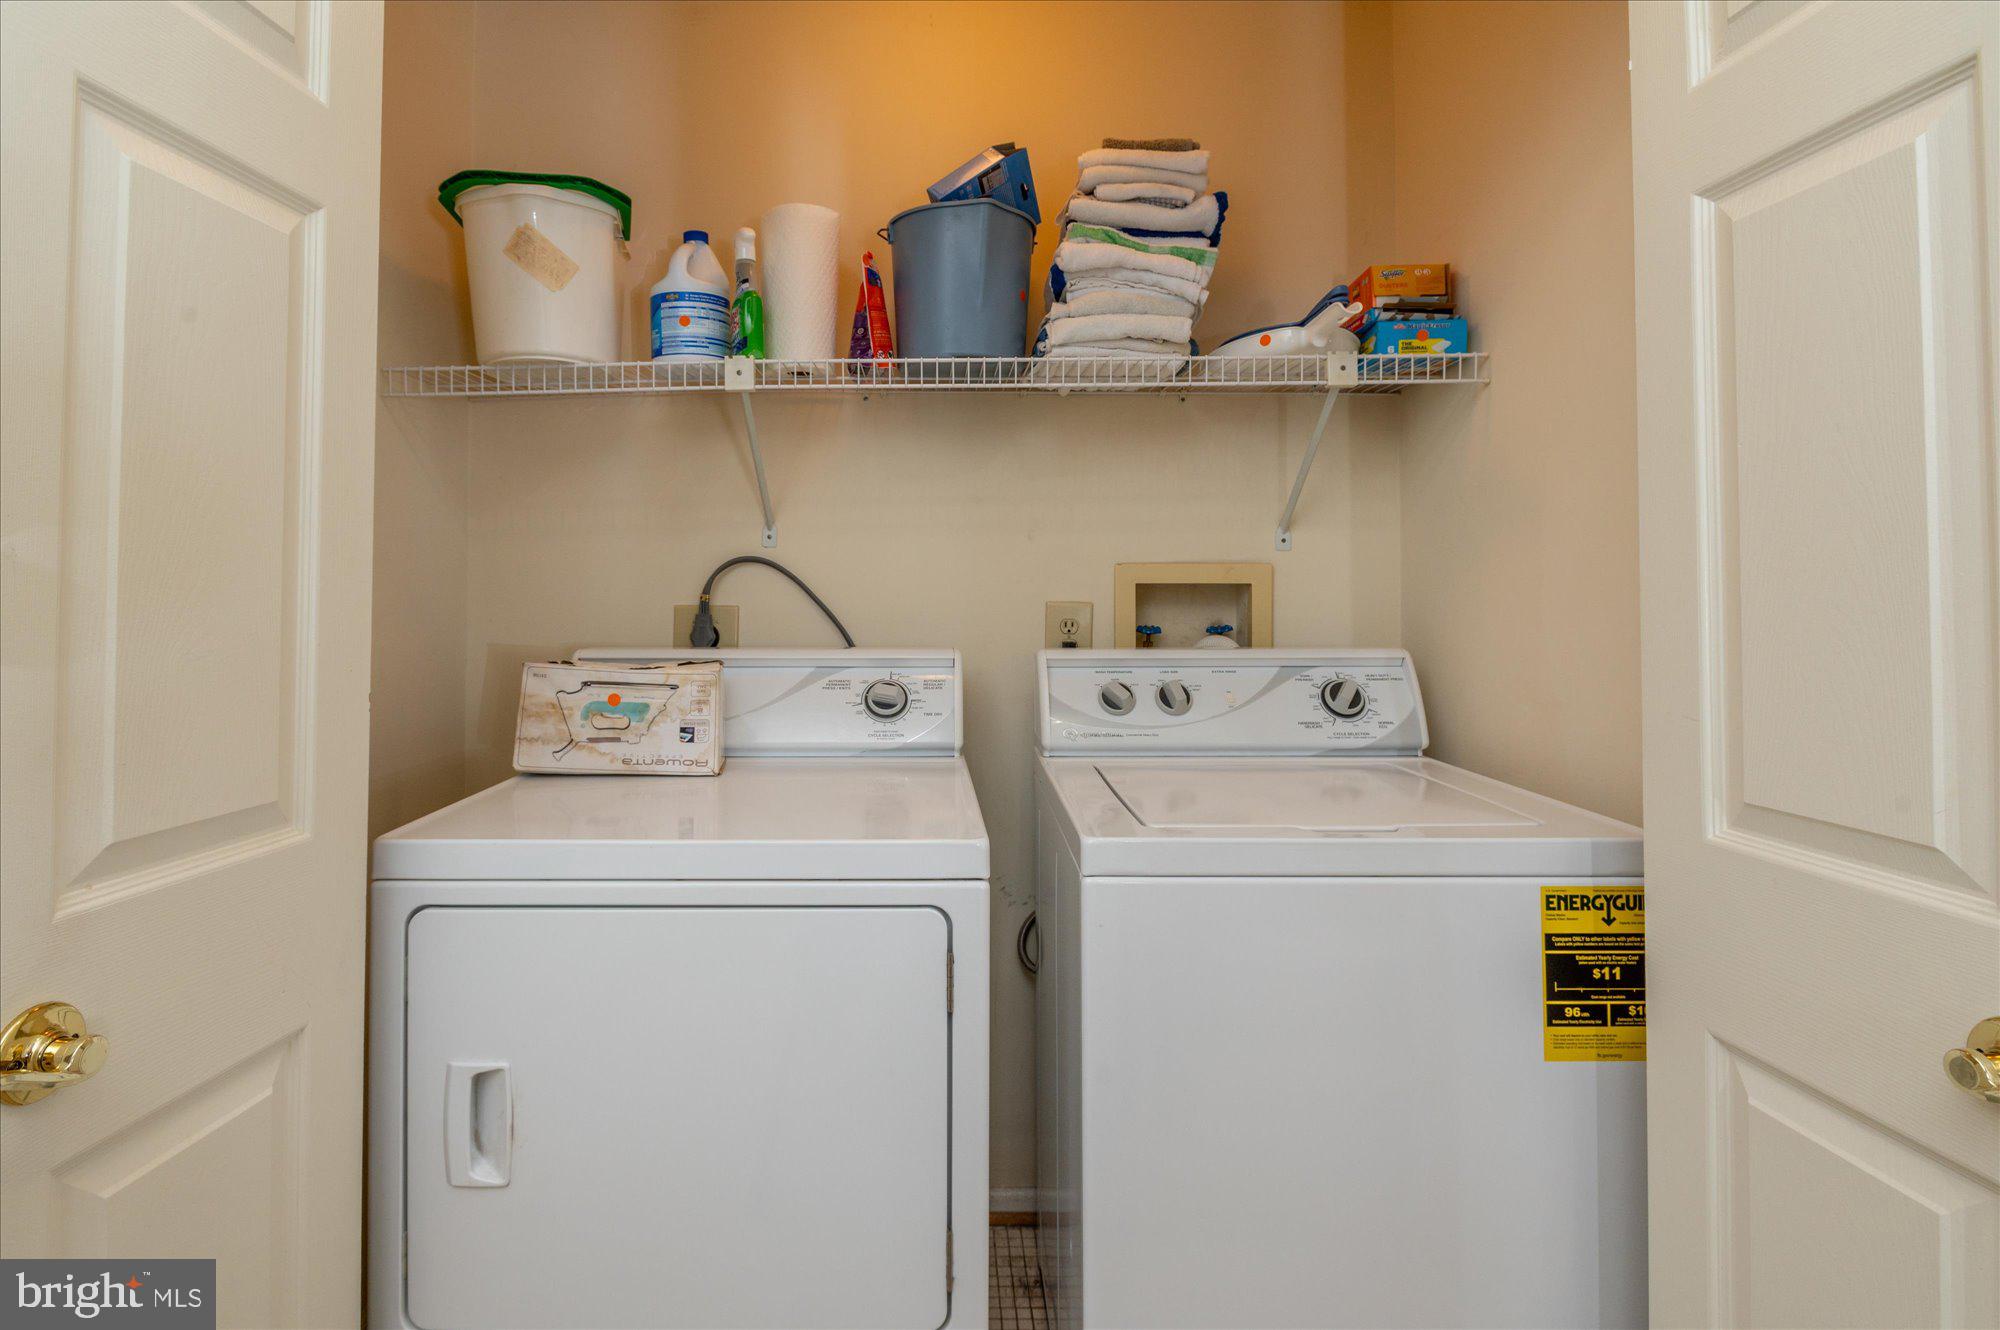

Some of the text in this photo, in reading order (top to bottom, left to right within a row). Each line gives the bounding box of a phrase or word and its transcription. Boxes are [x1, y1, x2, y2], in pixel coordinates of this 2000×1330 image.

[1545, 894, 1645, 912] ENERGYGUI
[1592, 966, 1621, 981] $11
[1564, 1006, 1581, 1017] 96
[1628, 1004, 1646, 1016] $1
